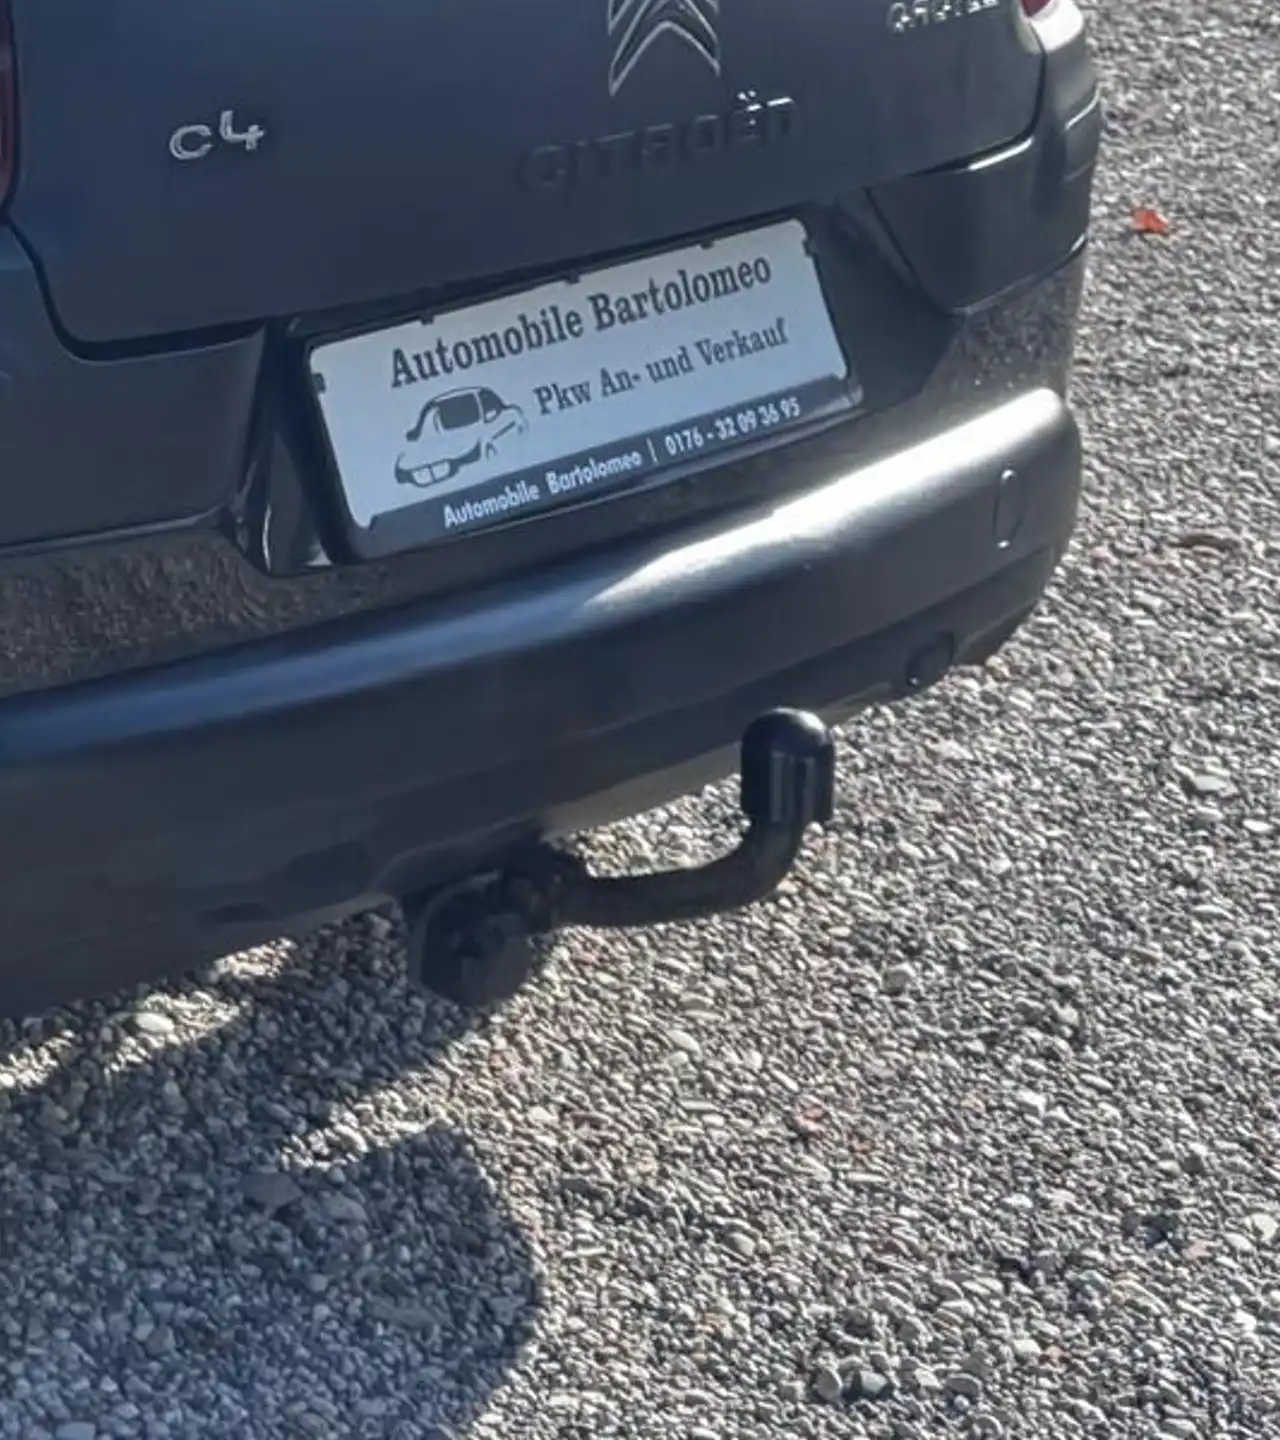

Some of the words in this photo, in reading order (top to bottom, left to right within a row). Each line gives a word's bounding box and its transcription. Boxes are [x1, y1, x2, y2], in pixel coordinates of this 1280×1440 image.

[168, 109, 267, 161] C4
[391, 305, 584, 388] Automobile
[588, 256, 772, 332] Bartolomeo
[532, 380, 591, 416] Pkw
[599, 367, 641, 398] An-
[645, 346, 695, 384] und
[694, 316, 789, 366] Verkauf
[443, 480, 541, 529] Automobile
[545, 450, 643, 495] Bartolomeo
[664, 426, 705, 456] 0176
[714, 415, 738, 441] 32
[736, 409, 758, 434] 09
